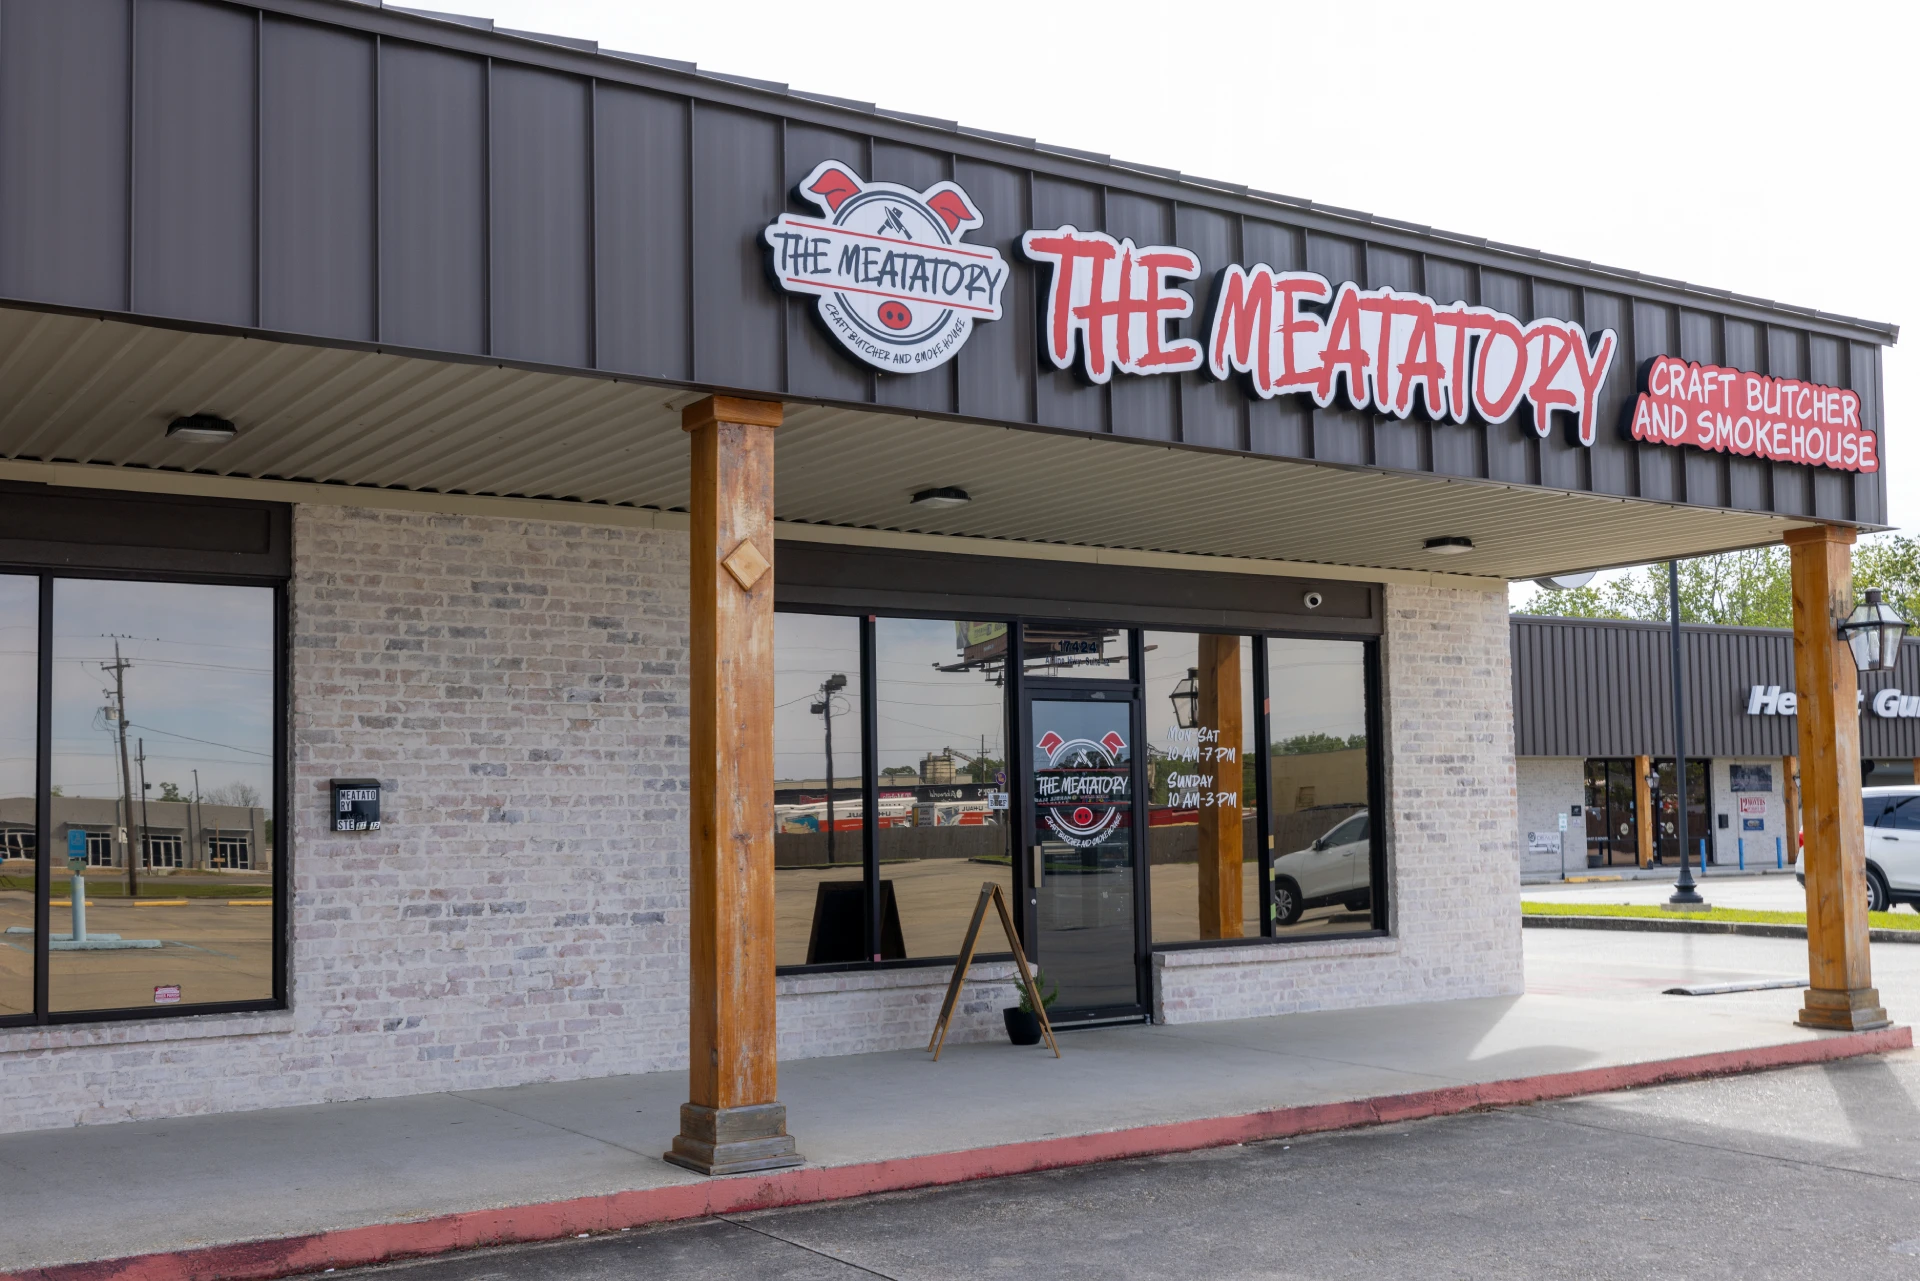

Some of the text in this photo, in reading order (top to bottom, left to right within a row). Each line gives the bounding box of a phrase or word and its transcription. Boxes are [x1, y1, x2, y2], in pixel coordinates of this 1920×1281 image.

[773, 231, 1002, 305] THE MEATATORY
[824, 303, 851, 334] CRAFT
[847, 328, 891, 361] BUTCHER
[892, 352, 912, 364] AND
[1028, 233, 1612, 442] THE MEATATORY
[1651, 361, 1858, 428] CRAFT BUTCHER
[1635, 399, 1876, 467] AND SMOKEHOUSE
[1058, 640, 1097, 653] 17424
[1167, 745, 1179, 761] 10
[1214, 746, 1236, 763] PM
[1036, 776, 1129, 796] THE MEATATORY
[1167, 771, 1214, 789] SUNDAY
[341, 790, 376, 800] MEATATO
[1167, 792, 1180, 808] 10
[1216, 792, 1237, 809] PM
[341, 801, 351, 811] RY
[338, 820, 354, 830] STE
